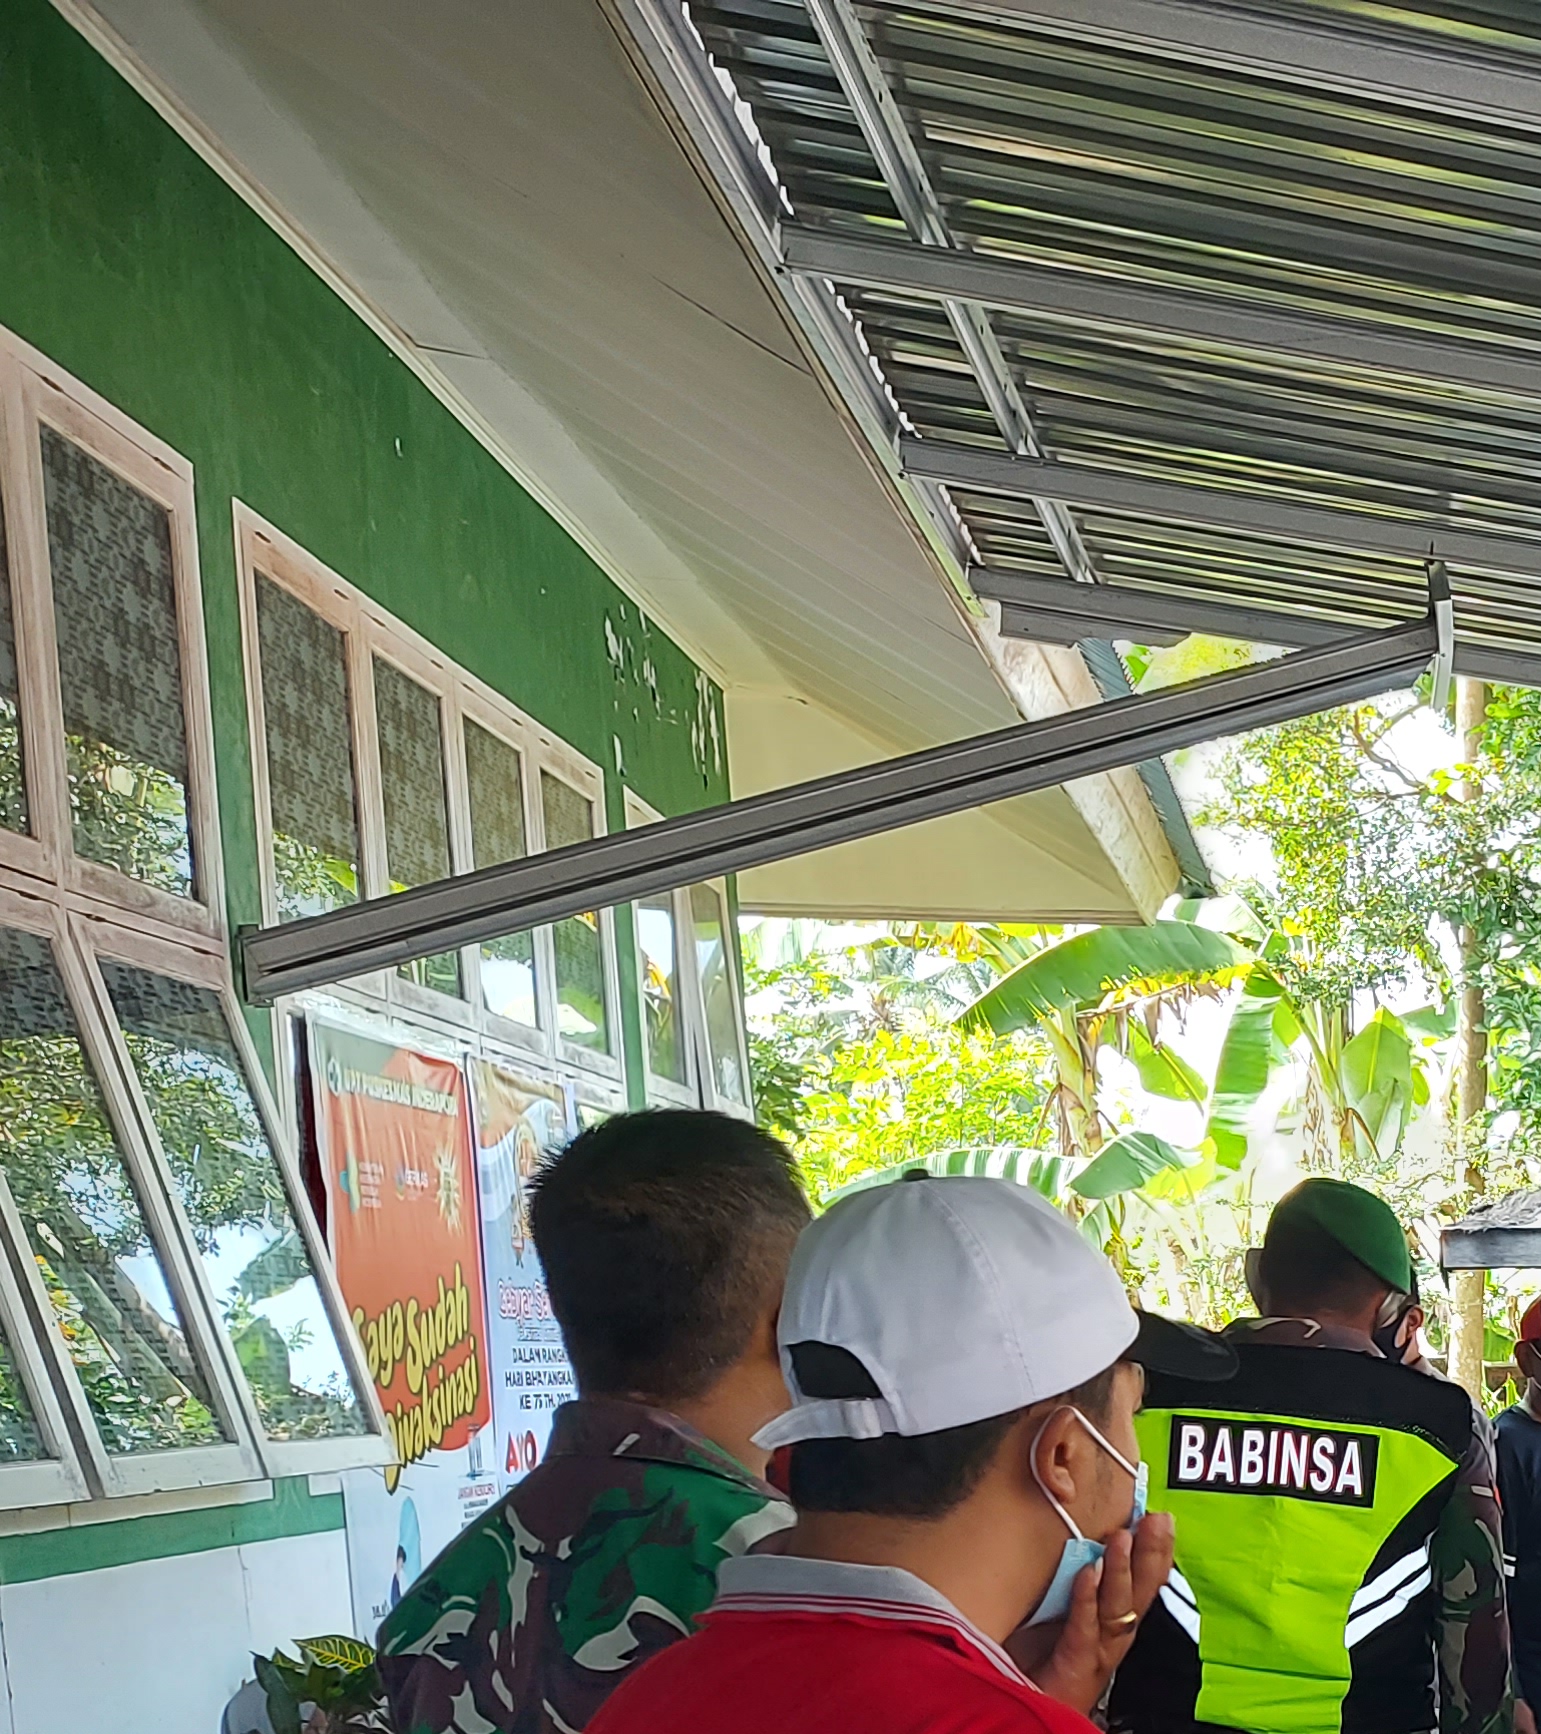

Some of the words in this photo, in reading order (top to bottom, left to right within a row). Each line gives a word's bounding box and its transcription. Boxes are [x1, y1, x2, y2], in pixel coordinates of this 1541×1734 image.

[405, 1260, 470, 1394] Sudah
[505, 1430, 537, 1474] AYO
[1178, 1423, 1363, 1497] BABINSA
